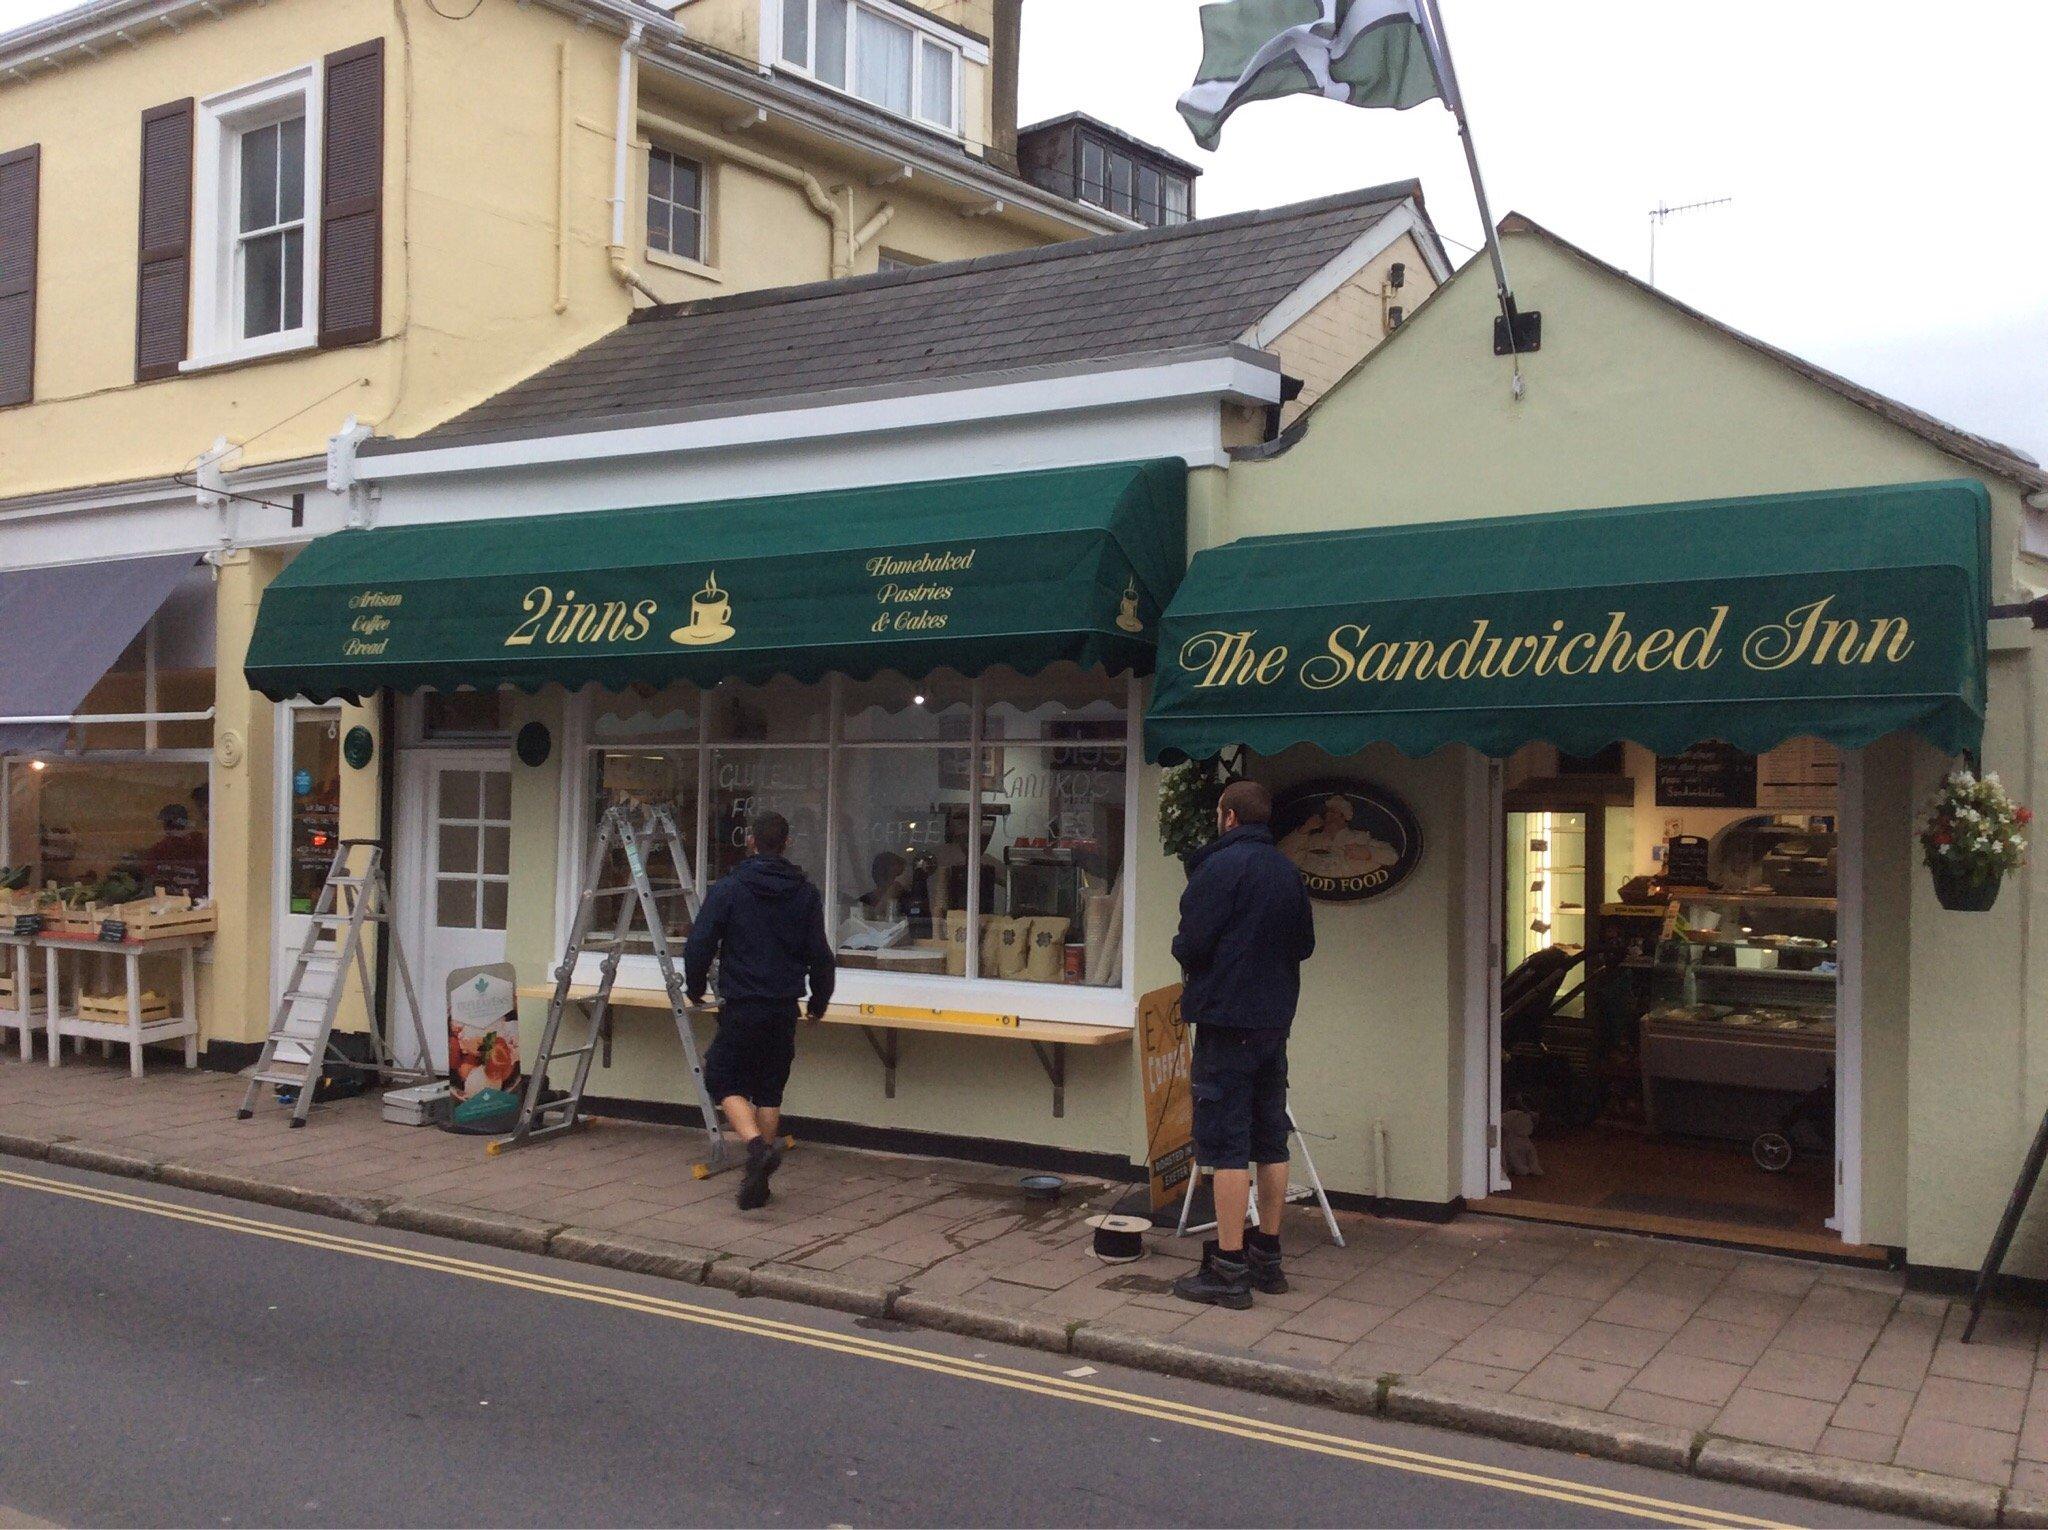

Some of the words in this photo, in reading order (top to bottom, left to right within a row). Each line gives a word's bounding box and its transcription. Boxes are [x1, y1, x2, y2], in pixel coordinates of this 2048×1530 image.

[866, 549, 976, 577] Homebaked
[348, 590, 403, 609] Artisan
[877, 583, 954, 604] Pastries
[351, 614, 391, 635] Coffee
[504, 586, 658, 646] 2inns
[871, 612, 891, 632] &
[894, 610, 948, 631] Cakes
[342, 637, 389, 656] Bread
[1179, 629, 1288, 688] The
[1300, 605, 1730, 690] Sandwiched
[1742, 594, 1915, 671] Inn
[1301, 873, 1336, 891] OOD
[1341, 869, 1389, 891] FOOD
